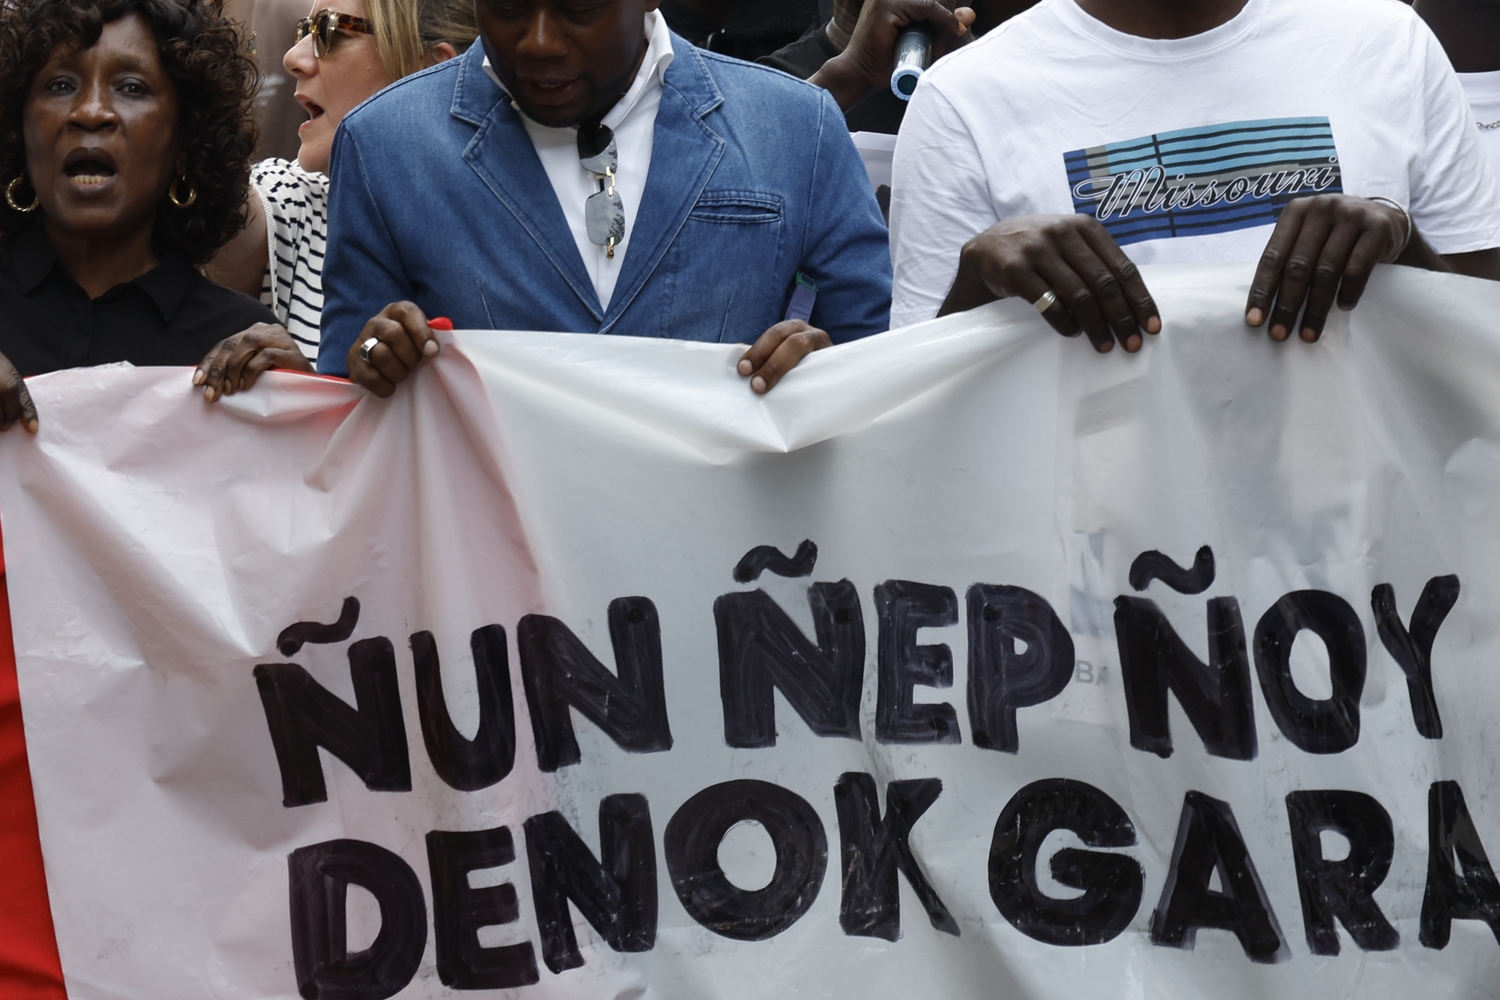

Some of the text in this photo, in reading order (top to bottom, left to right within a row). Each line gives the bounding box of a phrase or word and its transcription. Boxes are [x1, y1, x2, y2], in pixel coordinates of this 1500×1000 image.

[1073, 155, 1338, 221] Missouri
[252, 538, 1460, 808] ÑUN ÑEP ÑOY
[287, 771, 1500, 1000] DENOK GARA
